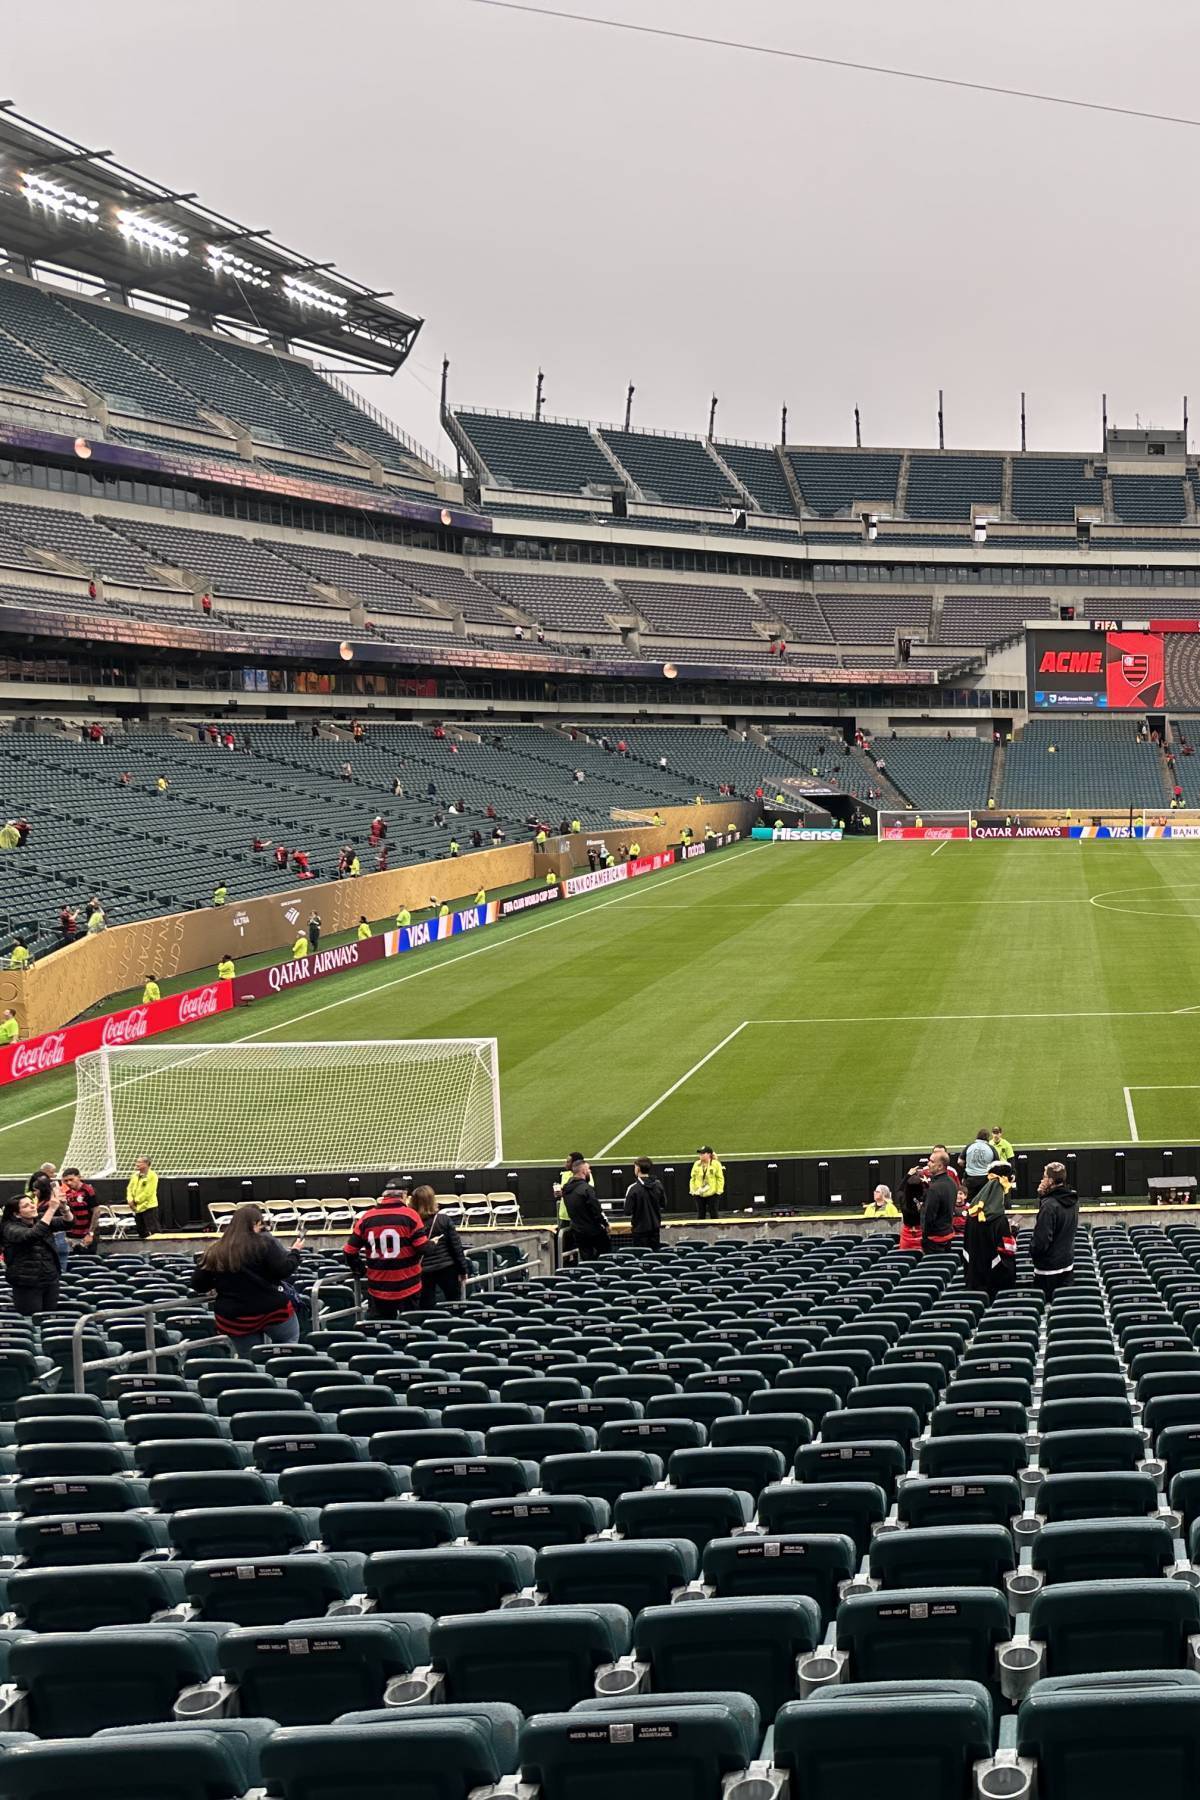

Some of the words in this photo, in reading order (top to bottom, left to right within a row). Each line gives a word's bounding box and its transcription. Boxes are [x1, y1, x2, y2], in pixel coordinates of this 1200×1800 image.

[1094, 621, 1118, 630] FIFA
[772, 828, 842, 840] Hisense
[976, 827, 1011, 838] QATAR
[1016, 827, 1061, 837] AIRWAYS
[1106, 827, 1136, 837] VISA
[233, 916, 249, 927] ULTRA
[460, 908, 480, 931] VISA
[408, 922, 430, 948] VISA
[269, 958, 310, 992] QATAR
[313, 943, 359, 976] AIRWAYS
[179, 986, 218, 1022] Coca-Cola
[102, 1008, 149, 1046] Coca-Cola
[12, 1033, 66, 1077] Coca-Cola
[368, 1228, 400, 1258] 10
